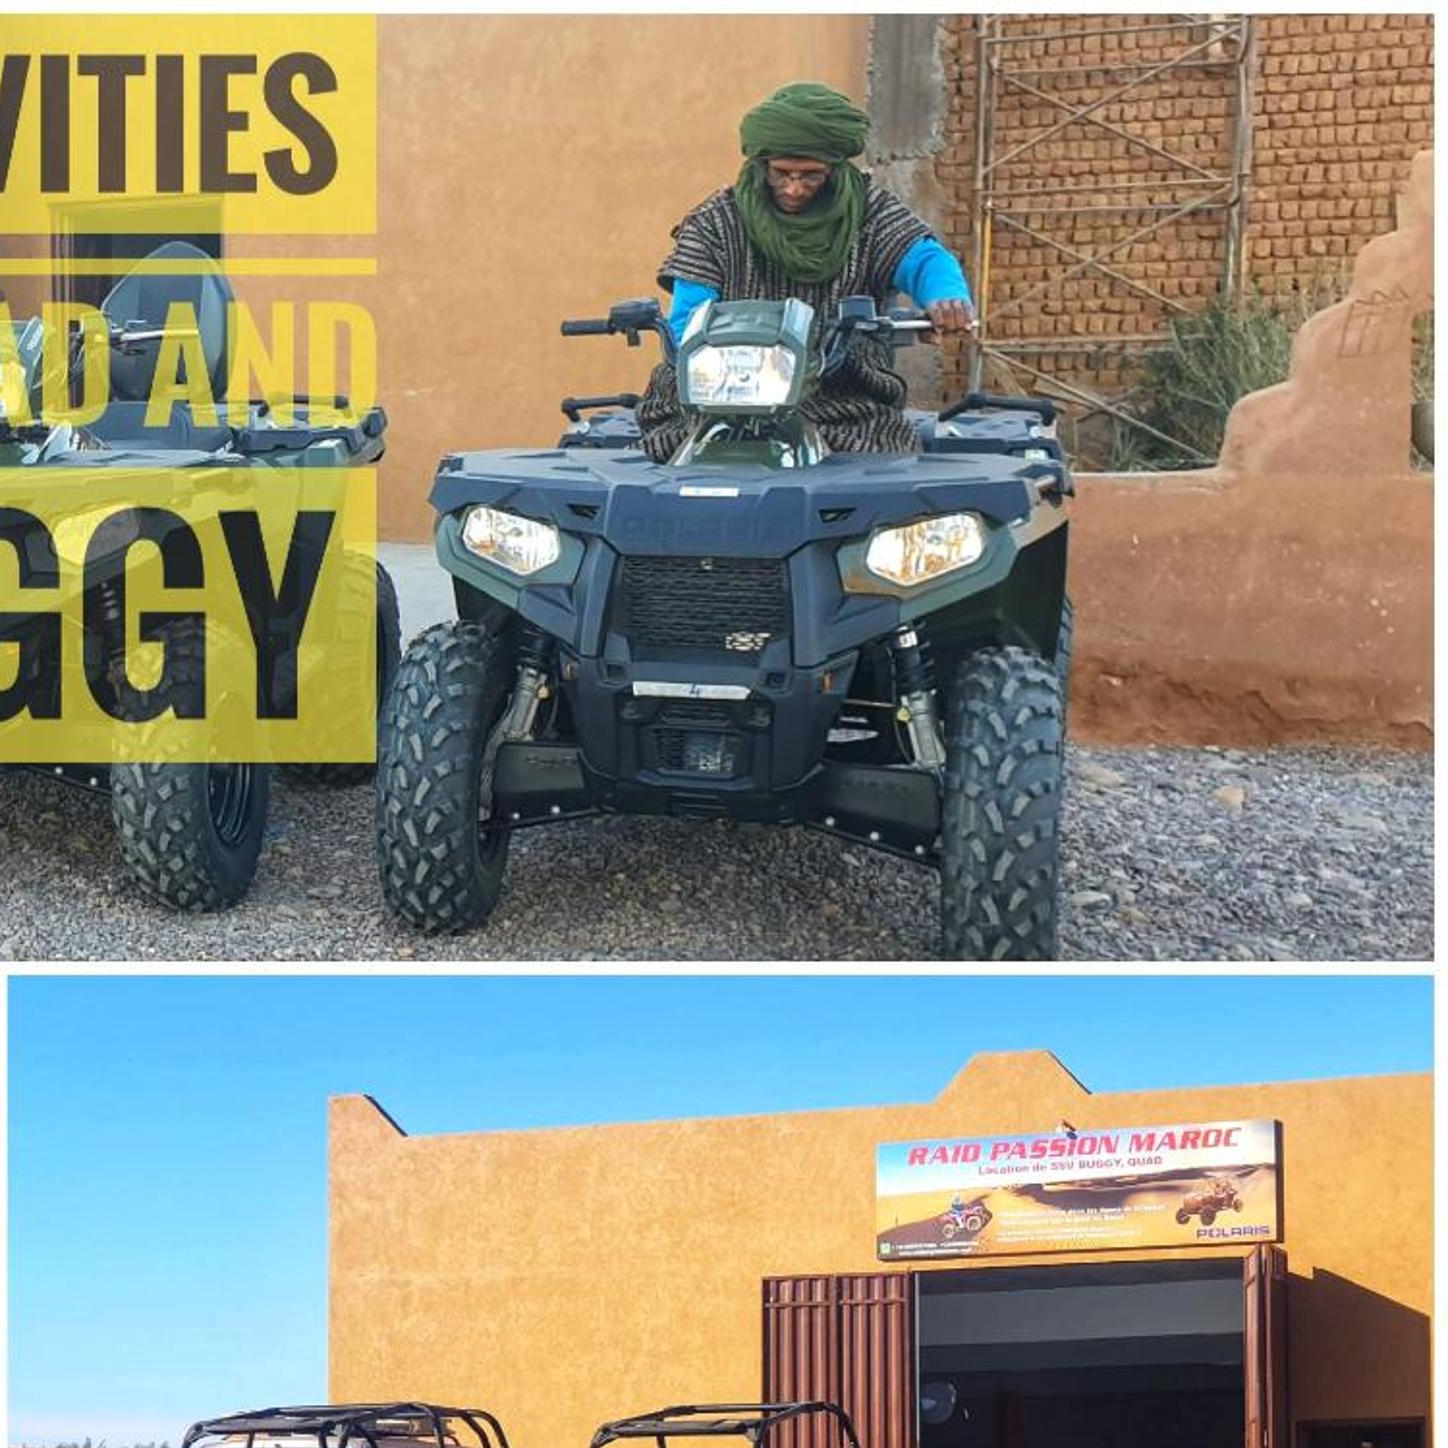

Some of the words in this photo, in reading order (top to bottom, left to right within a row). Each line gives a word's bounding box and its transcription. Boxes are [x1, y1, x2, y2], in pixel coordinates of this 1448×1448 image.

[908, 1143, 982, 1166] RAID
[990, 1135, 1120, 1161] PASSION
[1129, 1127, 1242, 1153] MAROC
[978, 1165, 1029, 1176] Location
[1079, 1158, 1124, 1169] BUGGY,
[1128, 1156, 1163, 1167] QUAD
[1196, 1225, 1270, 1238] POLARIS
